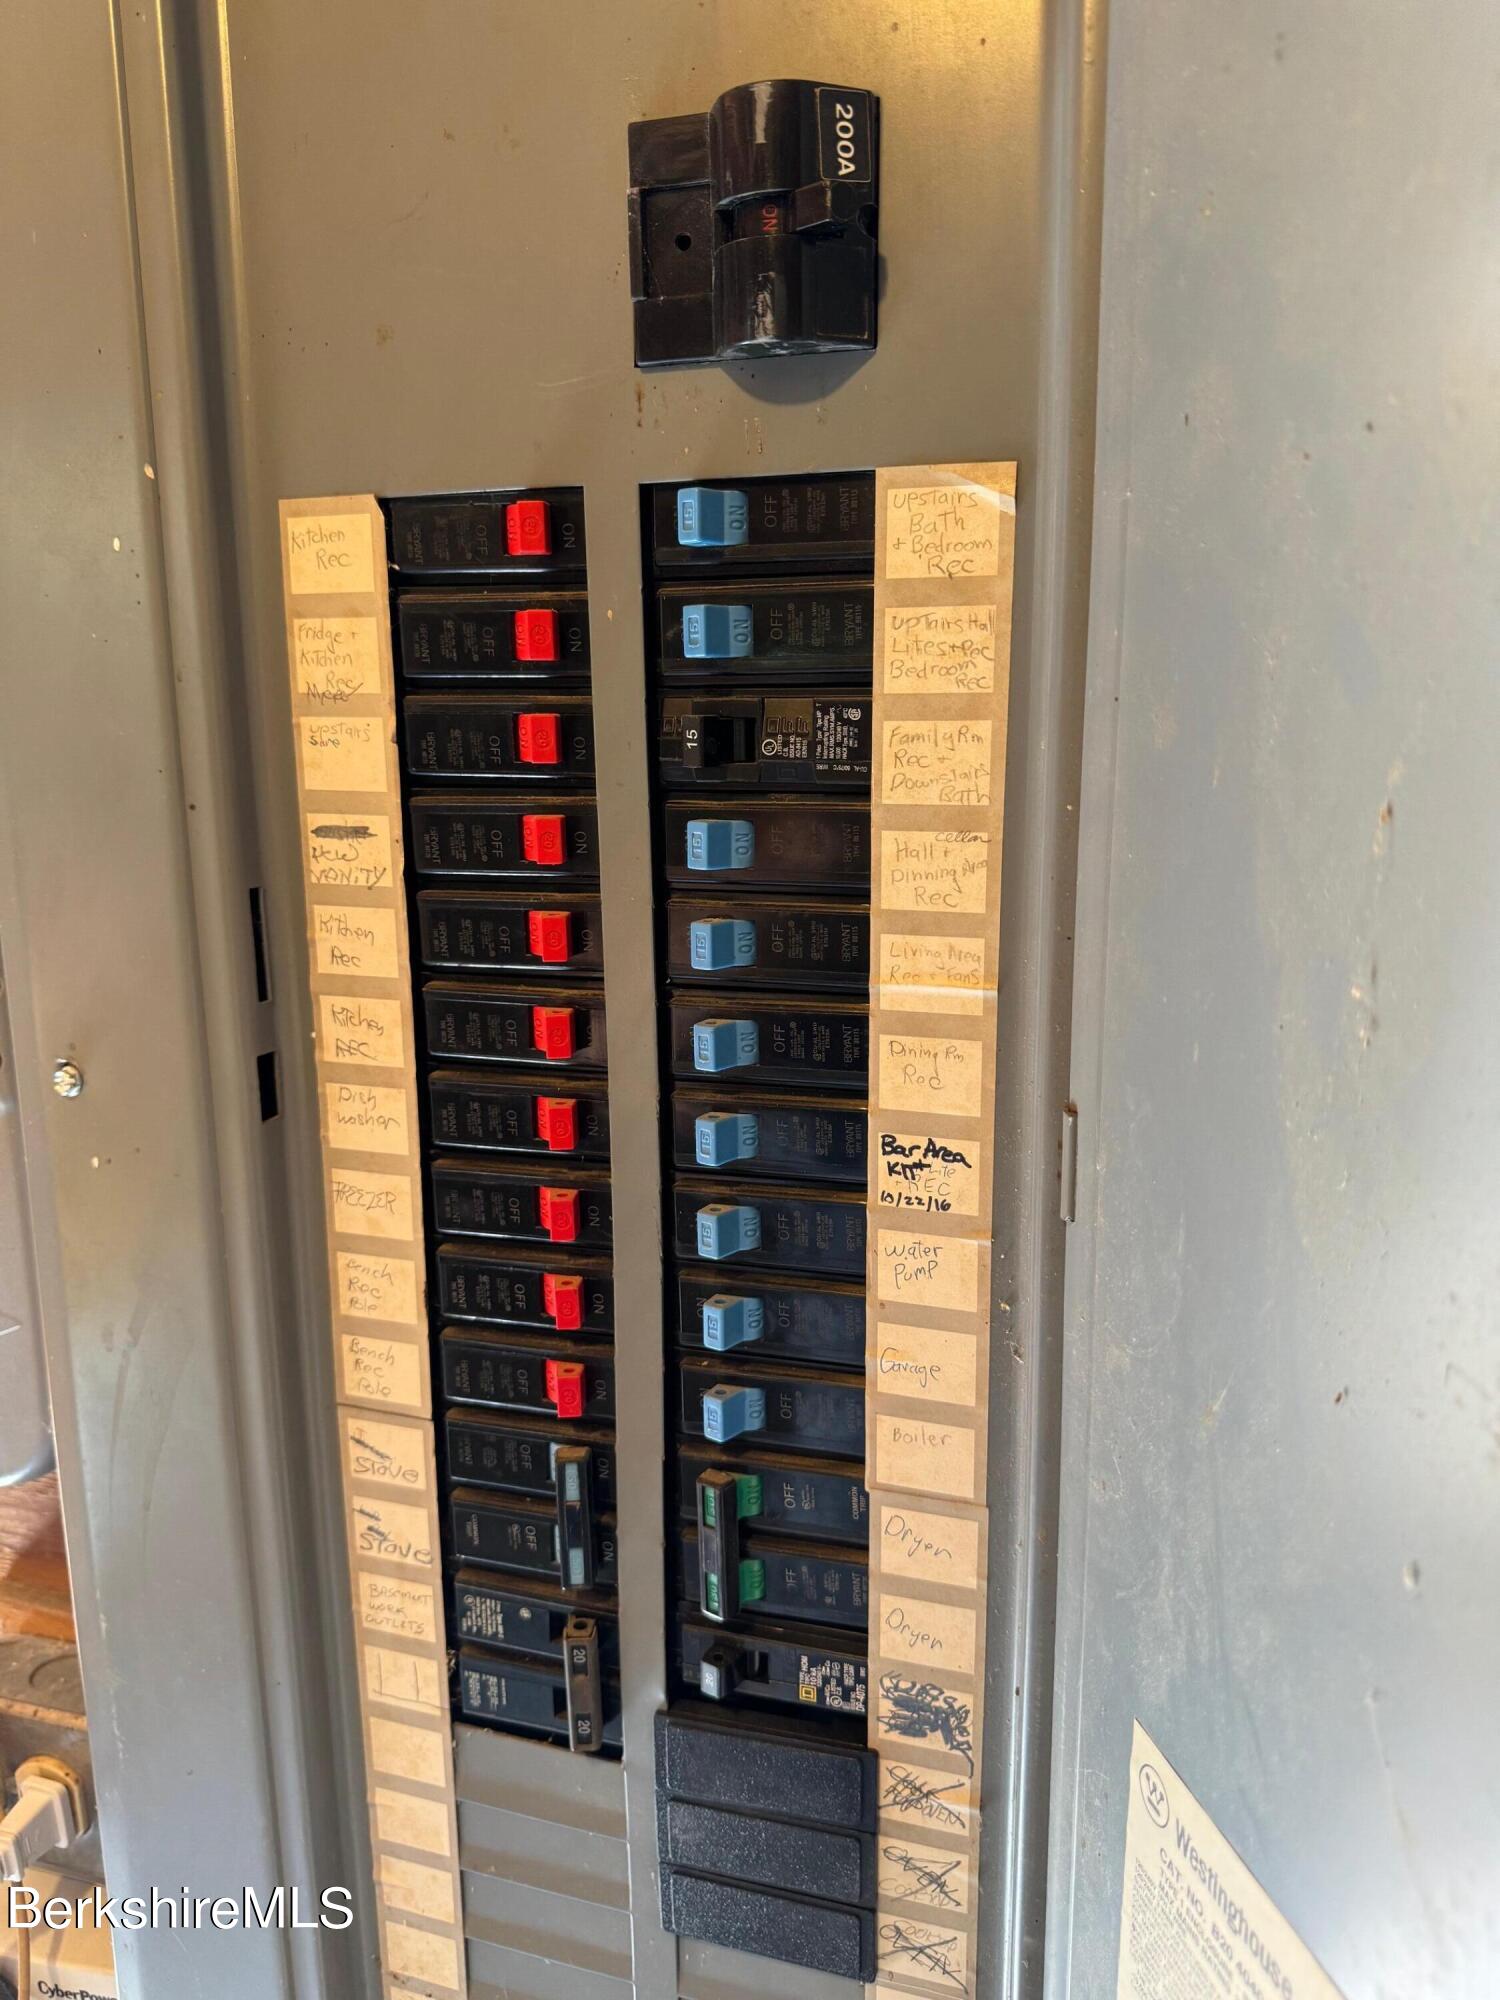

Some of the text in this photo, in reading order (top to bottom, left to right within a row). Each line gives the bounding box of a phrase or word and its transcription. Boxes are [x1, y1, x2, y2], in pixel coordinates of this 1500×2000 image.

[835, 103, 856, 177] 200A
[762, 203, 778, 232] ON
[727, 504, 745, 530] ON
[764, 495, 777, 528] OFF
[474, 524, 488, 556] OFF
[562, 522, 577, 549] ON
[911, 535, 993, 556] Bedroom
[733, 618, 749, 644] ON
[770, 607, 783, 640] OFF
[482, 626, 495, 657] OFF
[569, 626, 582, 652] ON
[889, 658, 977, 680] Bedroom
[489, 735, 501, 765] OFF
[573, 736, 587, 760] ON
[686, 729, 698, 750] 15
[889, 724, 955, 751] Family
[893, 748, 931, 768] Rec
[490, 829, 503, 858] OFF
[575, 831, 588, 855] ON
[735, 831, 751, 856] ON
[894, 837, 934, 862] Hall
[914, 886, 959, 908] Rec
[499, 926, 511, 953] OFF
[582, 929, 594, 952] ON
[738, 931, 753, 954] ON
[772, 922, 785, 953] OFF
[505, 1019, 517, 1048] OFF
[740, 1031, 755, 1053] ON
[774, 1023, 786, 1053] OFF
[506, 1109, 519, 1136] OFF
[587, 1114, 599, 1136] ON
[742, 1124, 758, 1147] ON
[881, 1134, 972, 1169] Bar Area
[509, 1197, 521, 1224] OFF
[588, 1205, 600, 1227] ON
[744, 1216, 758, 1239] ON
[513, 1283, 526, 1310] OFF
[592, 1293, 605, 1315] ON
[748, 1307, 763, 1330] ON
[779, 1300, 791, 1328] OFF
[880, 1346, 941, 1388] Garage
[516, 1368, 529, 1395] OFF
[594, 1379, 607, 1400] ON
[749, 1398, 764, 1419] ON
[780, 1392, 793, 1419] OFF
[892, 1425, 953, 1447] Boiler
[520, 1443, 533, 1471] OFF
[598, 1457, 610, 1479] ON
[783, 1481, 797, 1509] OFF
[851, 1486, 860, 1520] COMMON
[525, 1524, 538, 1551] OFF
[602, 1541, 615, 1562] ON
[573, 1649, 586, 1664] 20
[577, 1719, 591, 1735] 20
[1175, 1816, 1294, 2000] Westinghouse
